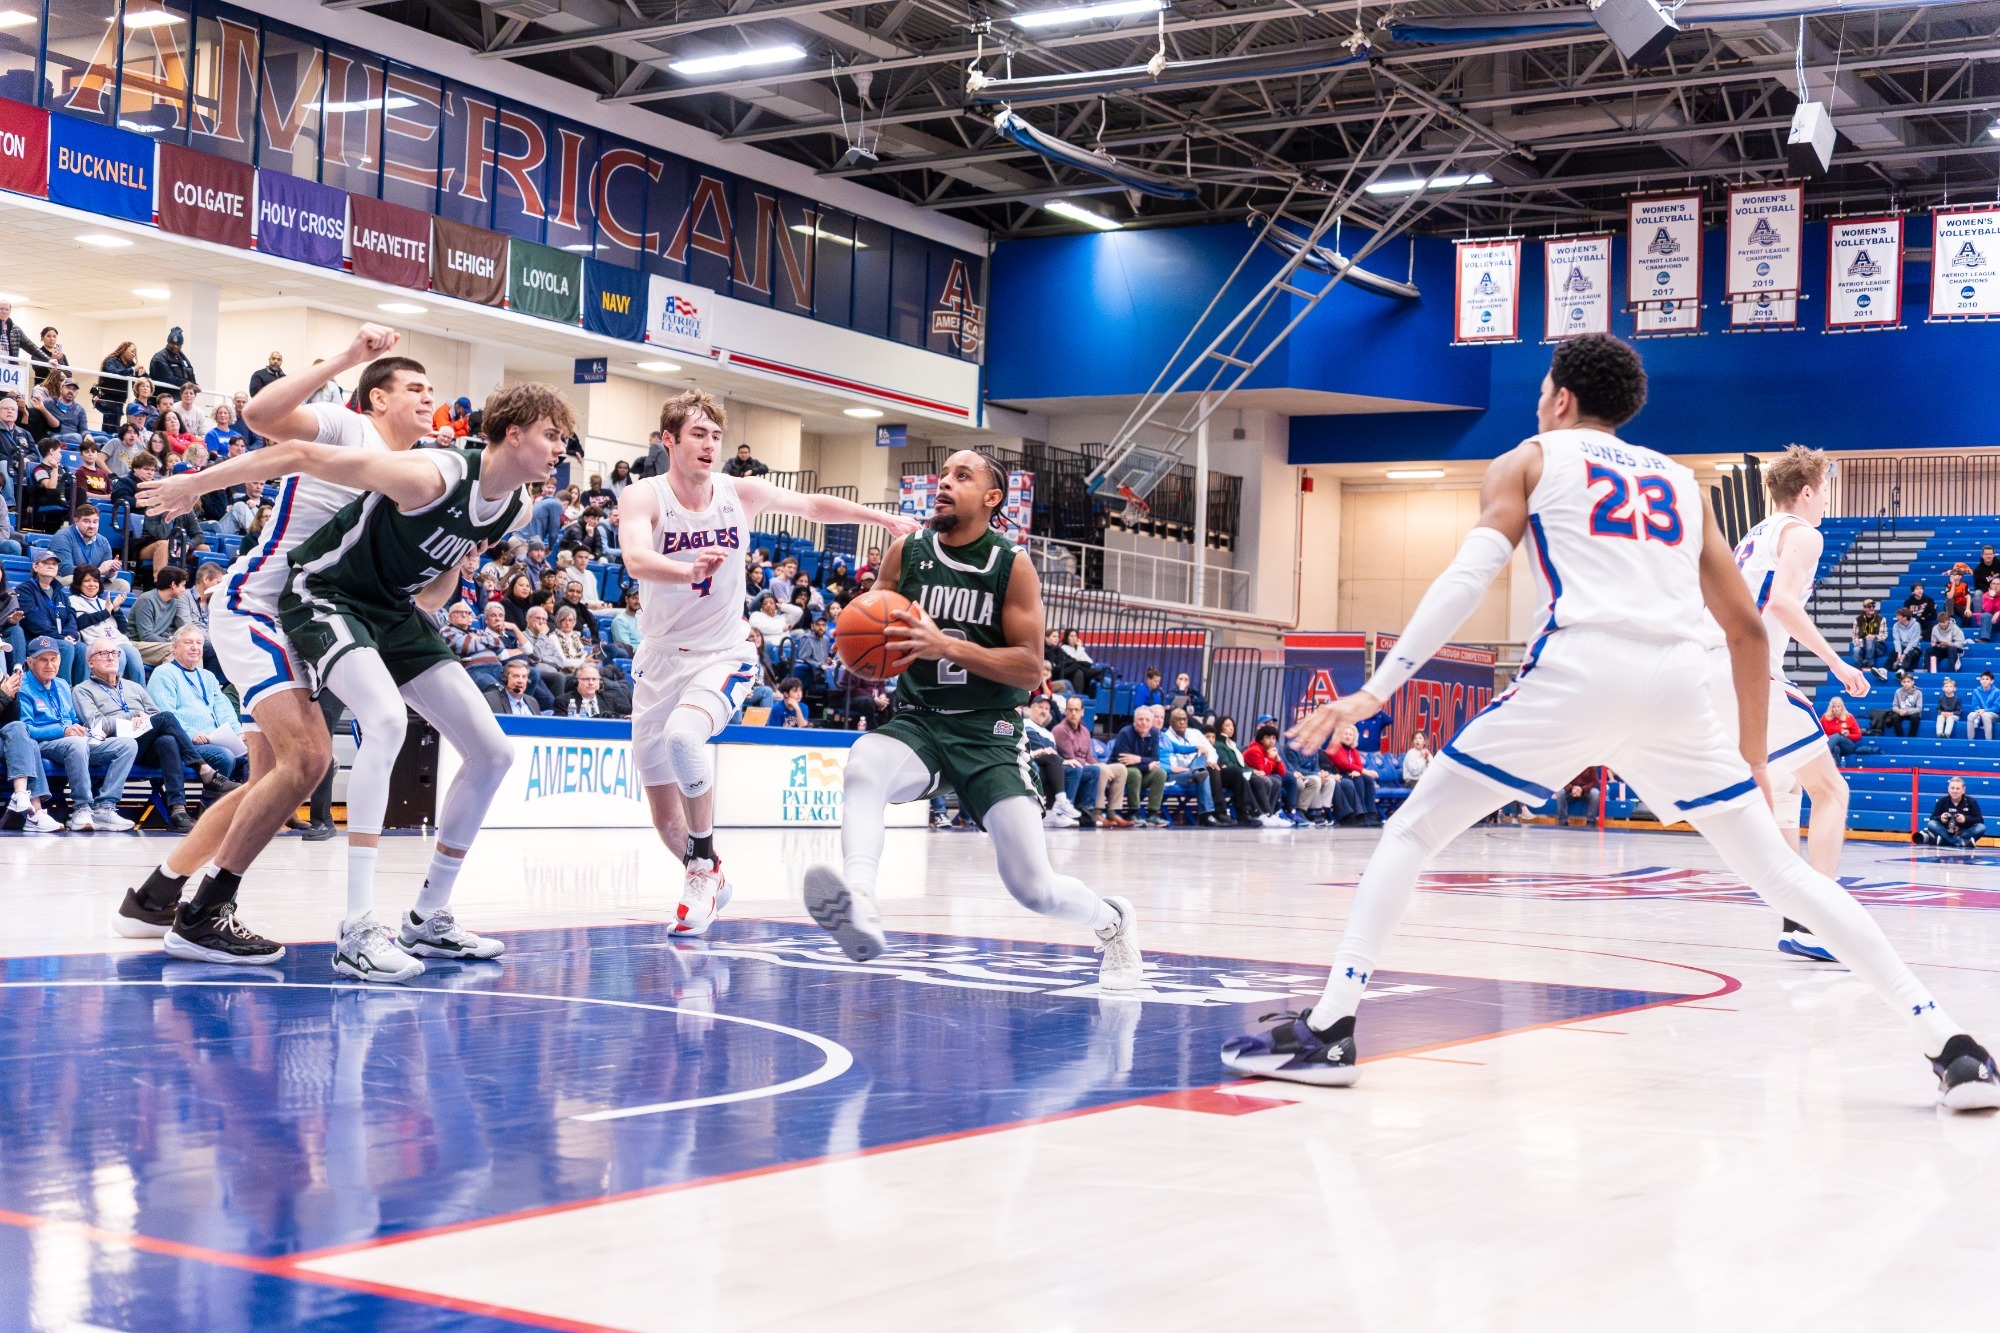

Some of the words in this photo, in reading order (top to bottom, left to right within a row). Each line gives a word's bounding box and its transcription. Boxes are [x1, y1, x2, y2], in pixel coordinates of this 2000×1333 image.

[64, 0, 824, 312] AMERICAN
[58, 146, 147, 190] BUCKNELL
[174, 181, 244, 218] COLGATE
[1642, 204, 1685, 214] WOMEN'S
[1735, 204, 1795, 215] VOLLEYBALL
[1742, 195, 1786, 204] WOMEN'S
[260, 200, 297, 229] HOLY
[299, 211, 344, 240] CROSS
[1636, 214, 1694, 224] VOLLEYBALL
[1946, 218, 1993, 227] WOMEN'S
[1834, 237, 1896, 247] VOLLEYBALL
[1841, 227, 1886, 236] WOMEN'S
[353, 225, 426, 263] LAFAYETTE
[447, 248, 494, 279] LEHIGH
[523, 267, 569, 296] LOYOLA
[1652, 288, 1674, 296] 2017
[602, 291, 631, 315] NAVY
[661, 321, 701, 338] LEAGUE
[662, 312, 702, 329] PATRIOT
[935, 316, 979, 336] AMERICA
[1580, 441, 1637, 467] JONES
[1584, 458, 1684, 546] 23
[418, 526, 482, 567] LOYO
[662, 526, 740, 555] EAGLES
[919, 584, 994, 626] LOYOLA
[937, 628, 967, 685] 2
[1460, 650, 1492, 663] COMPETITION
[782, 789, 845, 805] PATRIO
[783, 806, 841, 822] LEAGU
